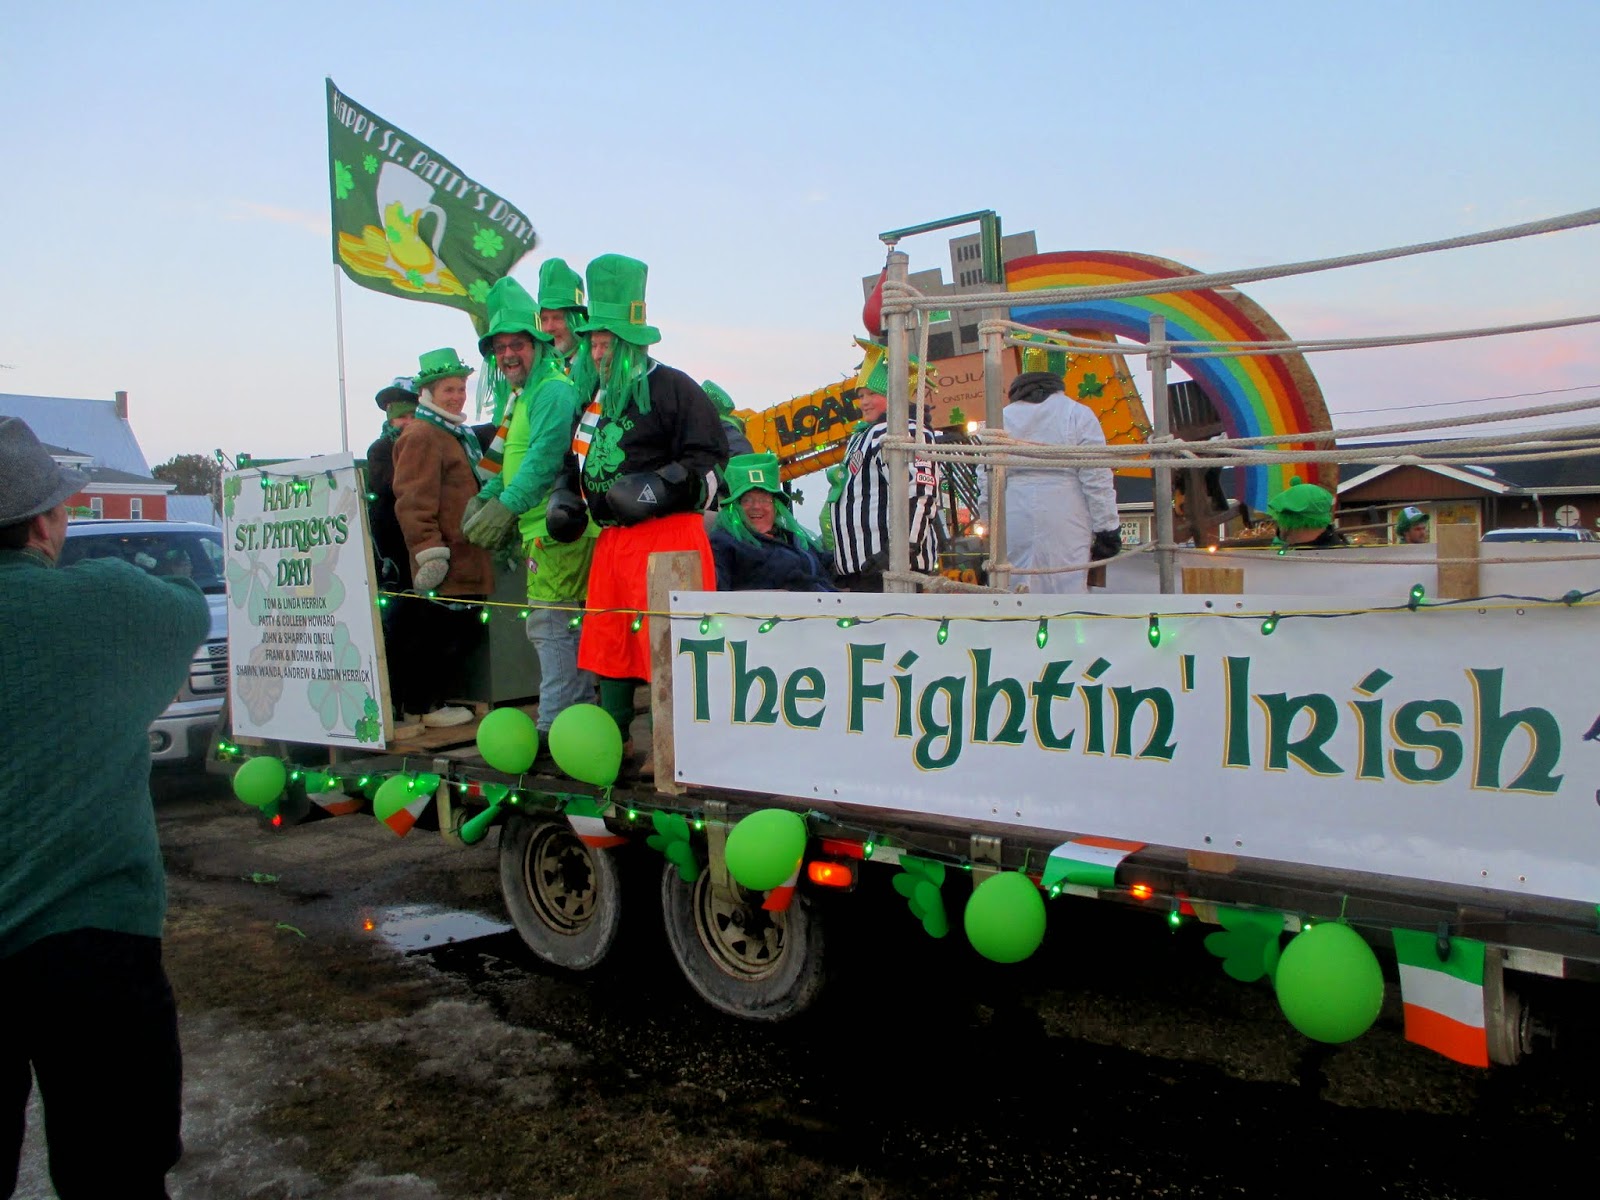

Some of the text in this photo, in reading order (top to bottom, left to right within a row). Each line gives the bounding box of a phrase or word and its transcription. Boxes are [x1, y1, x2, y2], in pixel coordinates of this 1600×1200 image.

[332, 90, 534, 245] HAPPY ST. PATTY'S DAY!
[262, 478, 316, 512] HAPPY
[234, 513, 349, 553] ST. PATRICK'S
[277, 557, 312, 587] DAY!
[263, 598, 277, 610] TOM
[283, 598, 301, 609] LINDA
[301, 597, 327, 609] HERRICK
[258, 615, 276, 626] PATTY
[281, 615, 307, 627] COLLEEN
[308, 615, 336, 627] HOWARD
[261, 632, 278, 644] JOHN
[283, 632, 313, 645] SHARRON
[265, 649, 285, 661] FRANK
[291, 650, 315, 662] NORMA
[315, 650, 333, 662] RYAN
[235, 664, 259, 677] SHAWN,
[284, 667, 311, 679] ANDREW
[317, 669, 341, 681] AUSTIN
[342, 670, 371, 682] HERRICK
[677, 636, 827, 730] The
[1221, 655, 1565, 796] Irish
